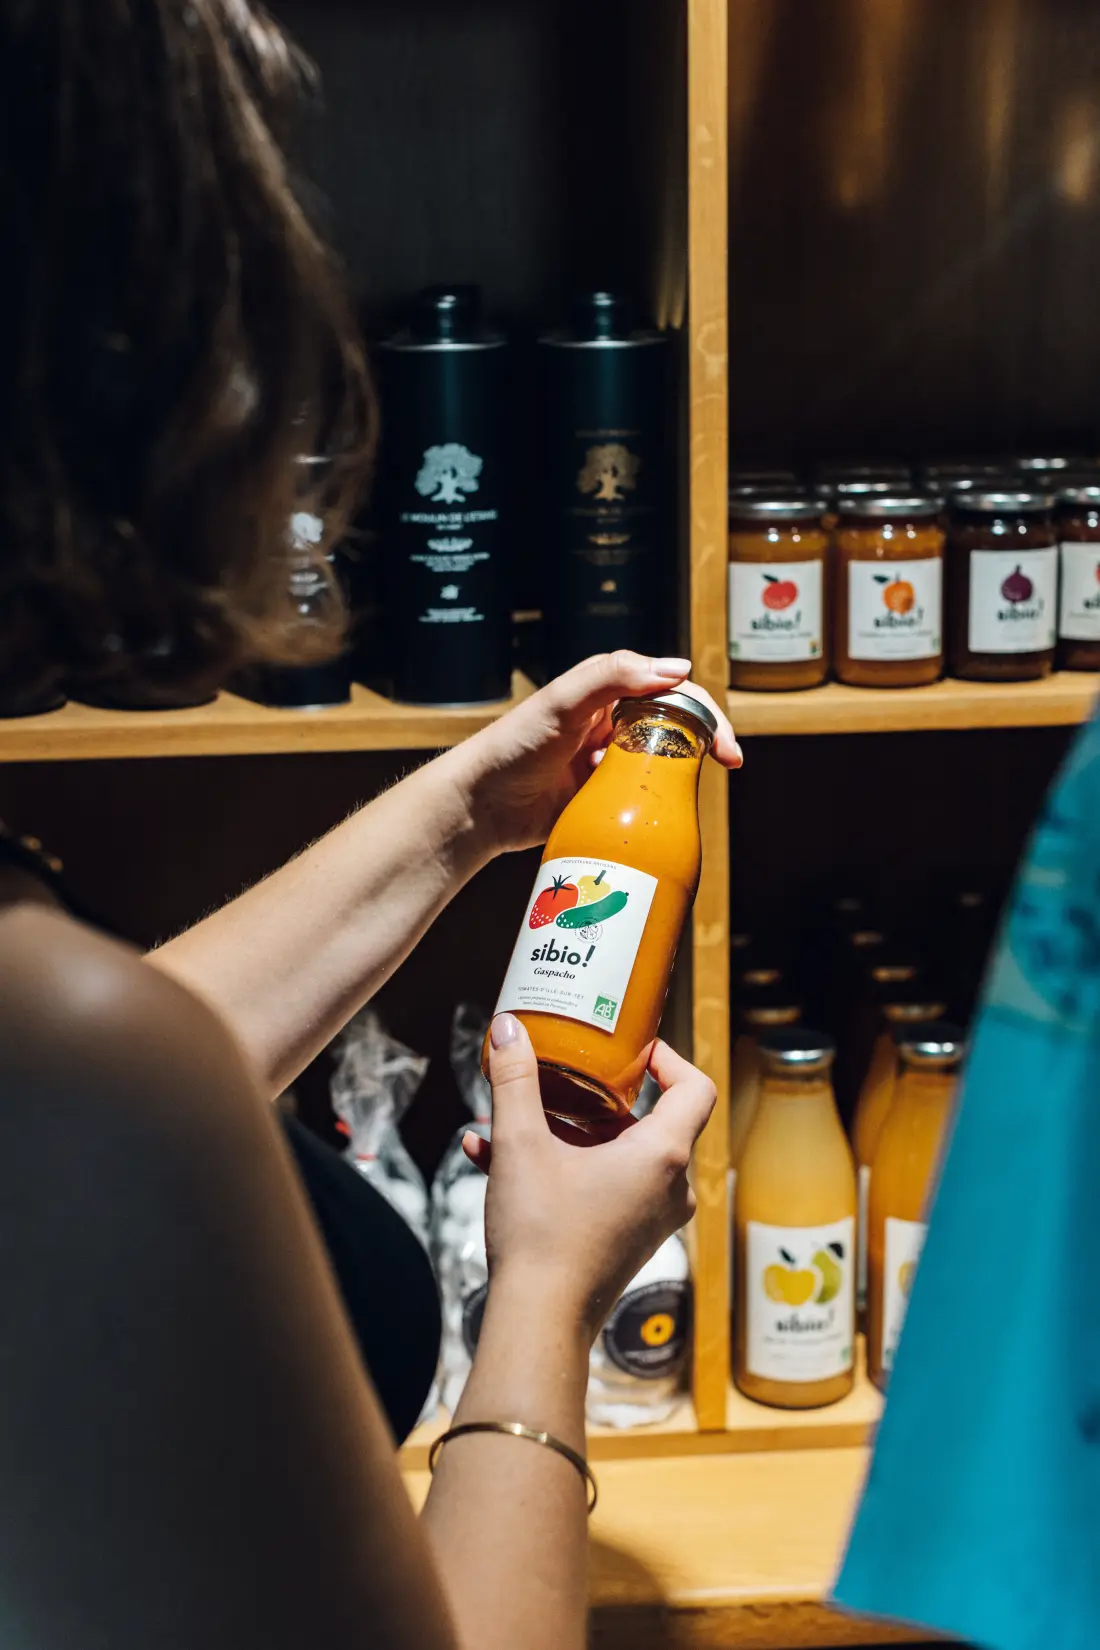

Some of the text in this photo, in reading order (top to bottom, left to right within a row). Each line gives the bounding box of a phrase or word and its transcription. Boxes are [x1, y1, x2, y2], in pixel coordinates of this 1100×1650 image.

[530, 938, 596, 968] sibio!
[533, 967, 576, 980] Gaspacho
[594, 1003, 612, 1018] AB
